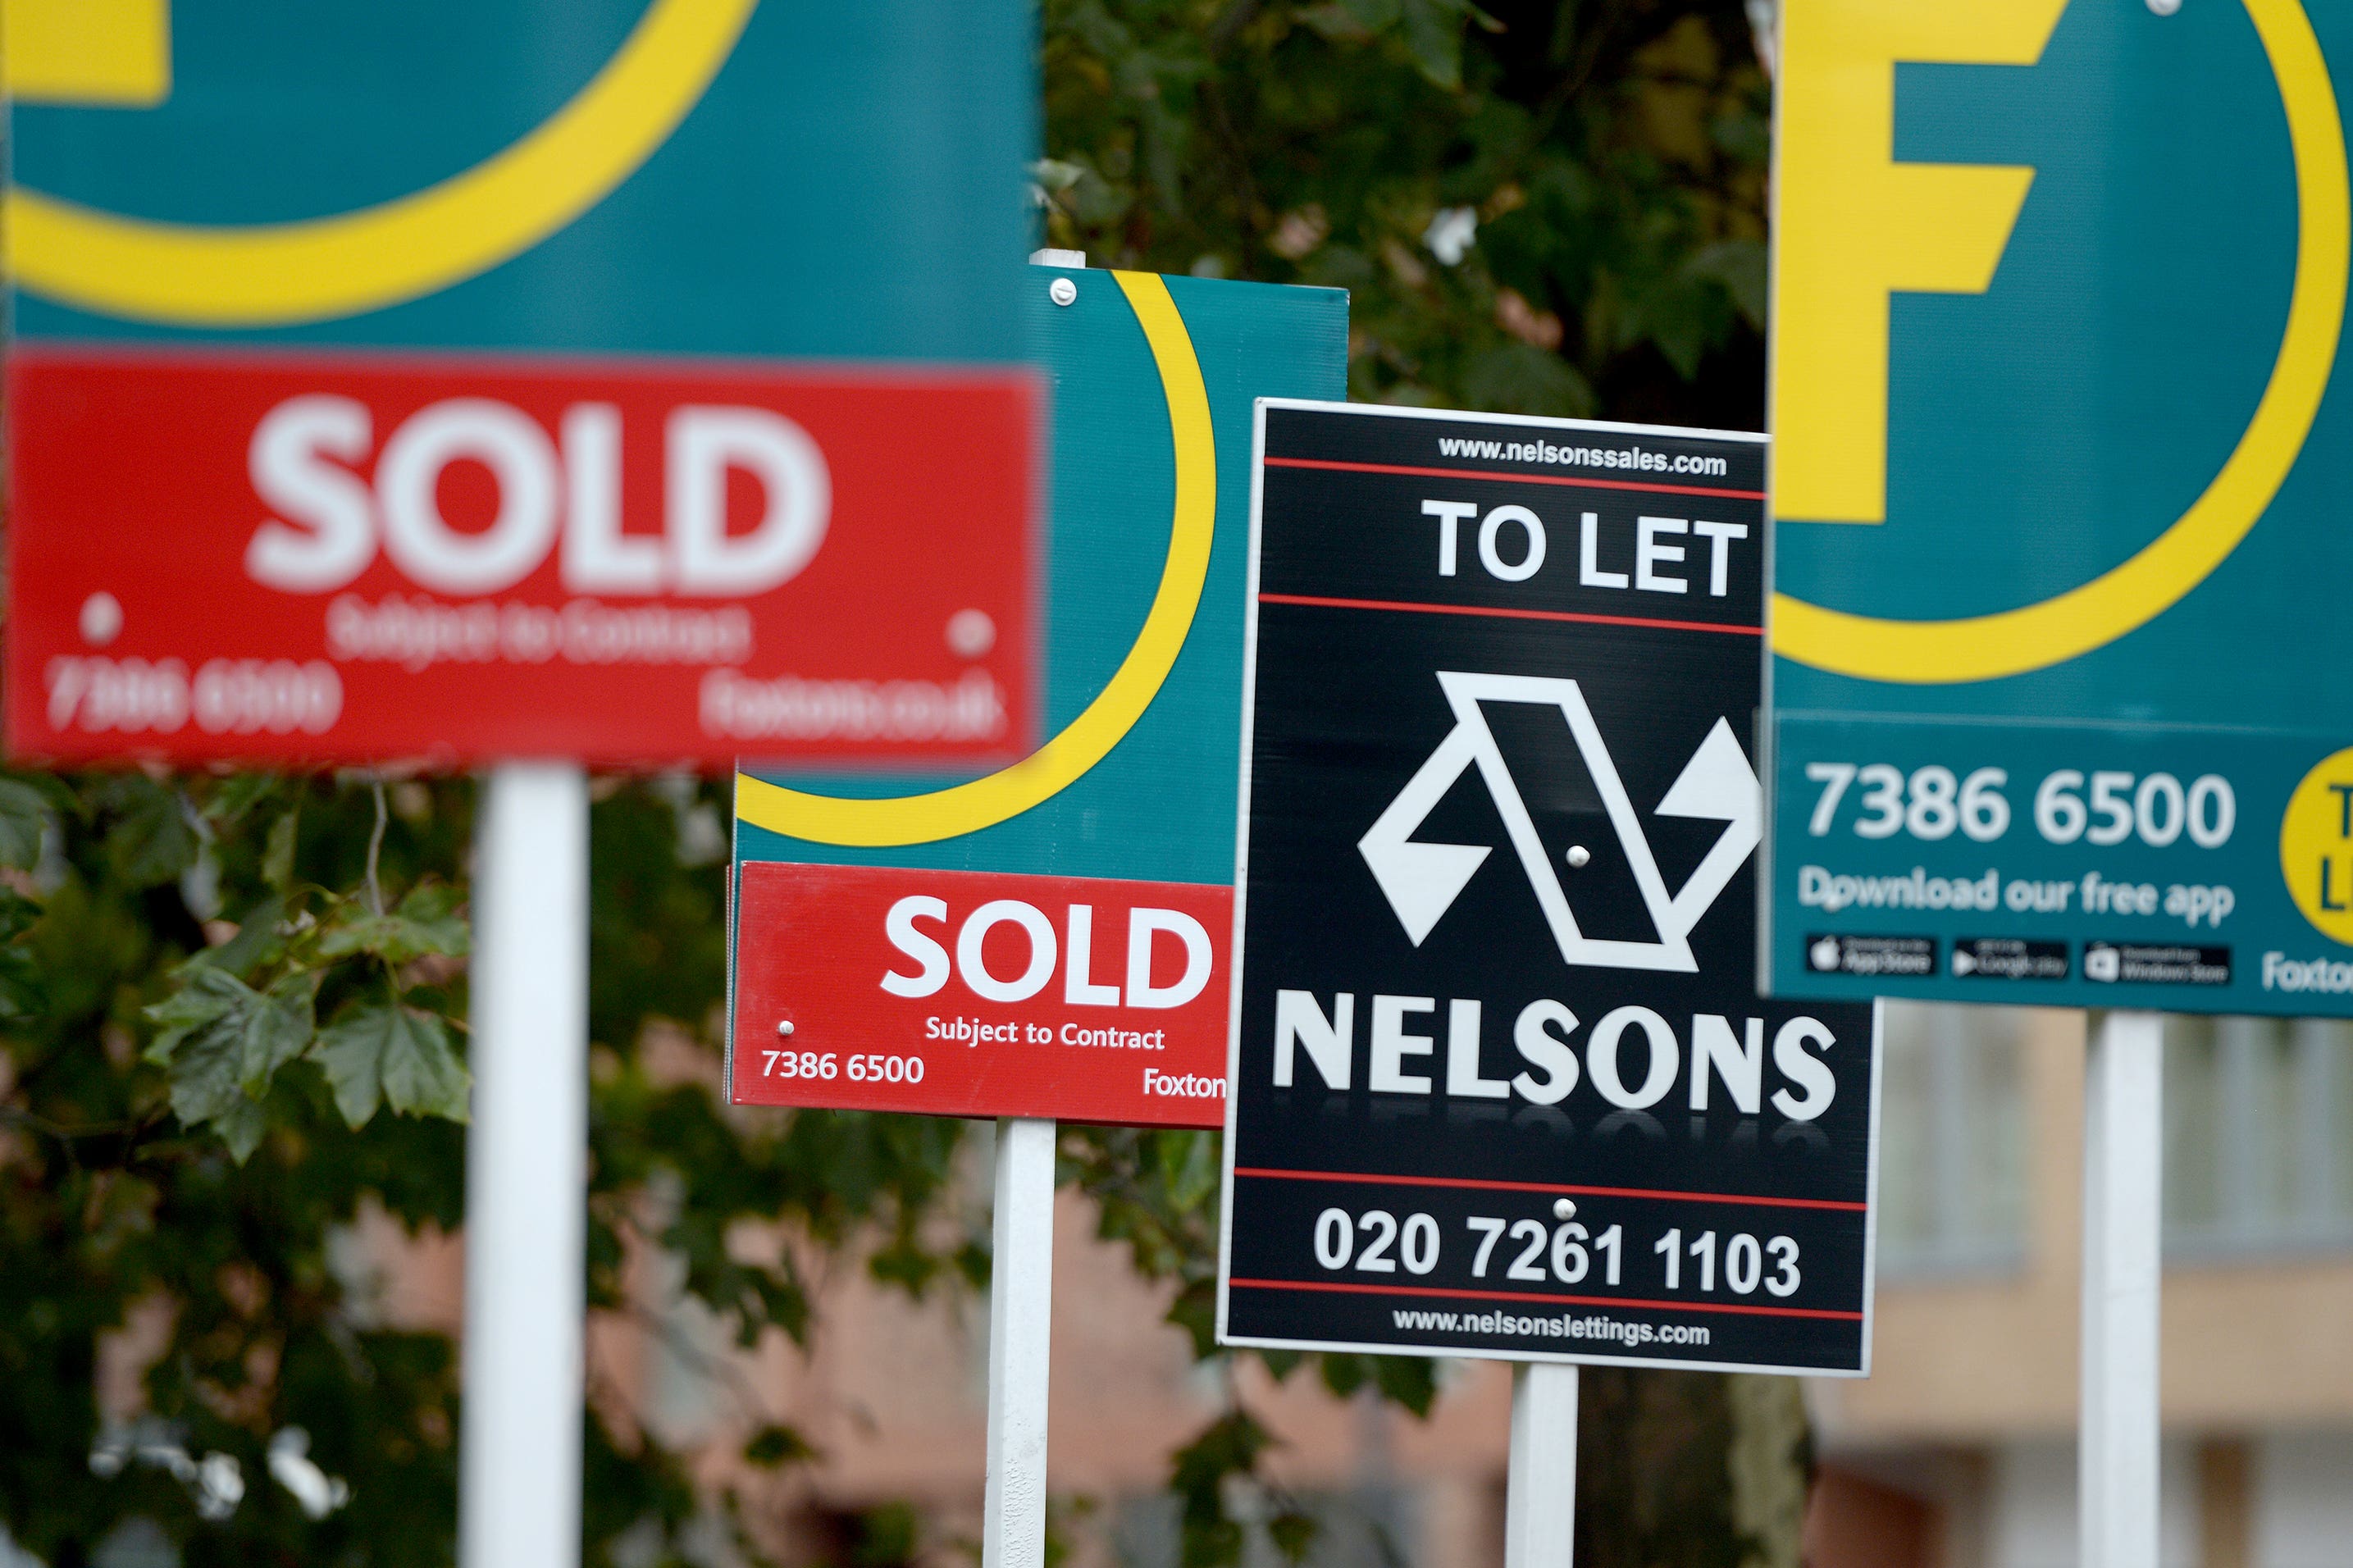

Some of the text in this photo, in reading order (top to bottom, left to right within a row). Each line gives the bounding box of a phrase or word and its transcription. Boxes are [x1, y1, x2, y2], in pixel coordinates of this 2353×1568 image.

[1439, 437, 1727, 476] www.nelsonssales.com
[248, 396, 831, 595] SOLD
[1421, 499, 1749, 597] TO LET
[1807, 763, 2237, 848] 7386 6500
[1799, 865, 2236, 927] Download our free app
[880, 895, 1212, 1009] SOLD
[2262, 951, 2353, 993] Foxto
[762, 1051, 924, 1083] 7386 6500
[926, 1016, 1165, 1051] Subject to Contract
[1273, 989, 1837, 1121] NELSONS
[1314, 1207, 1801, 1297] 020 7261 1103
[1393, 1310, 1710, 1347] www.nelsonslettings.com
